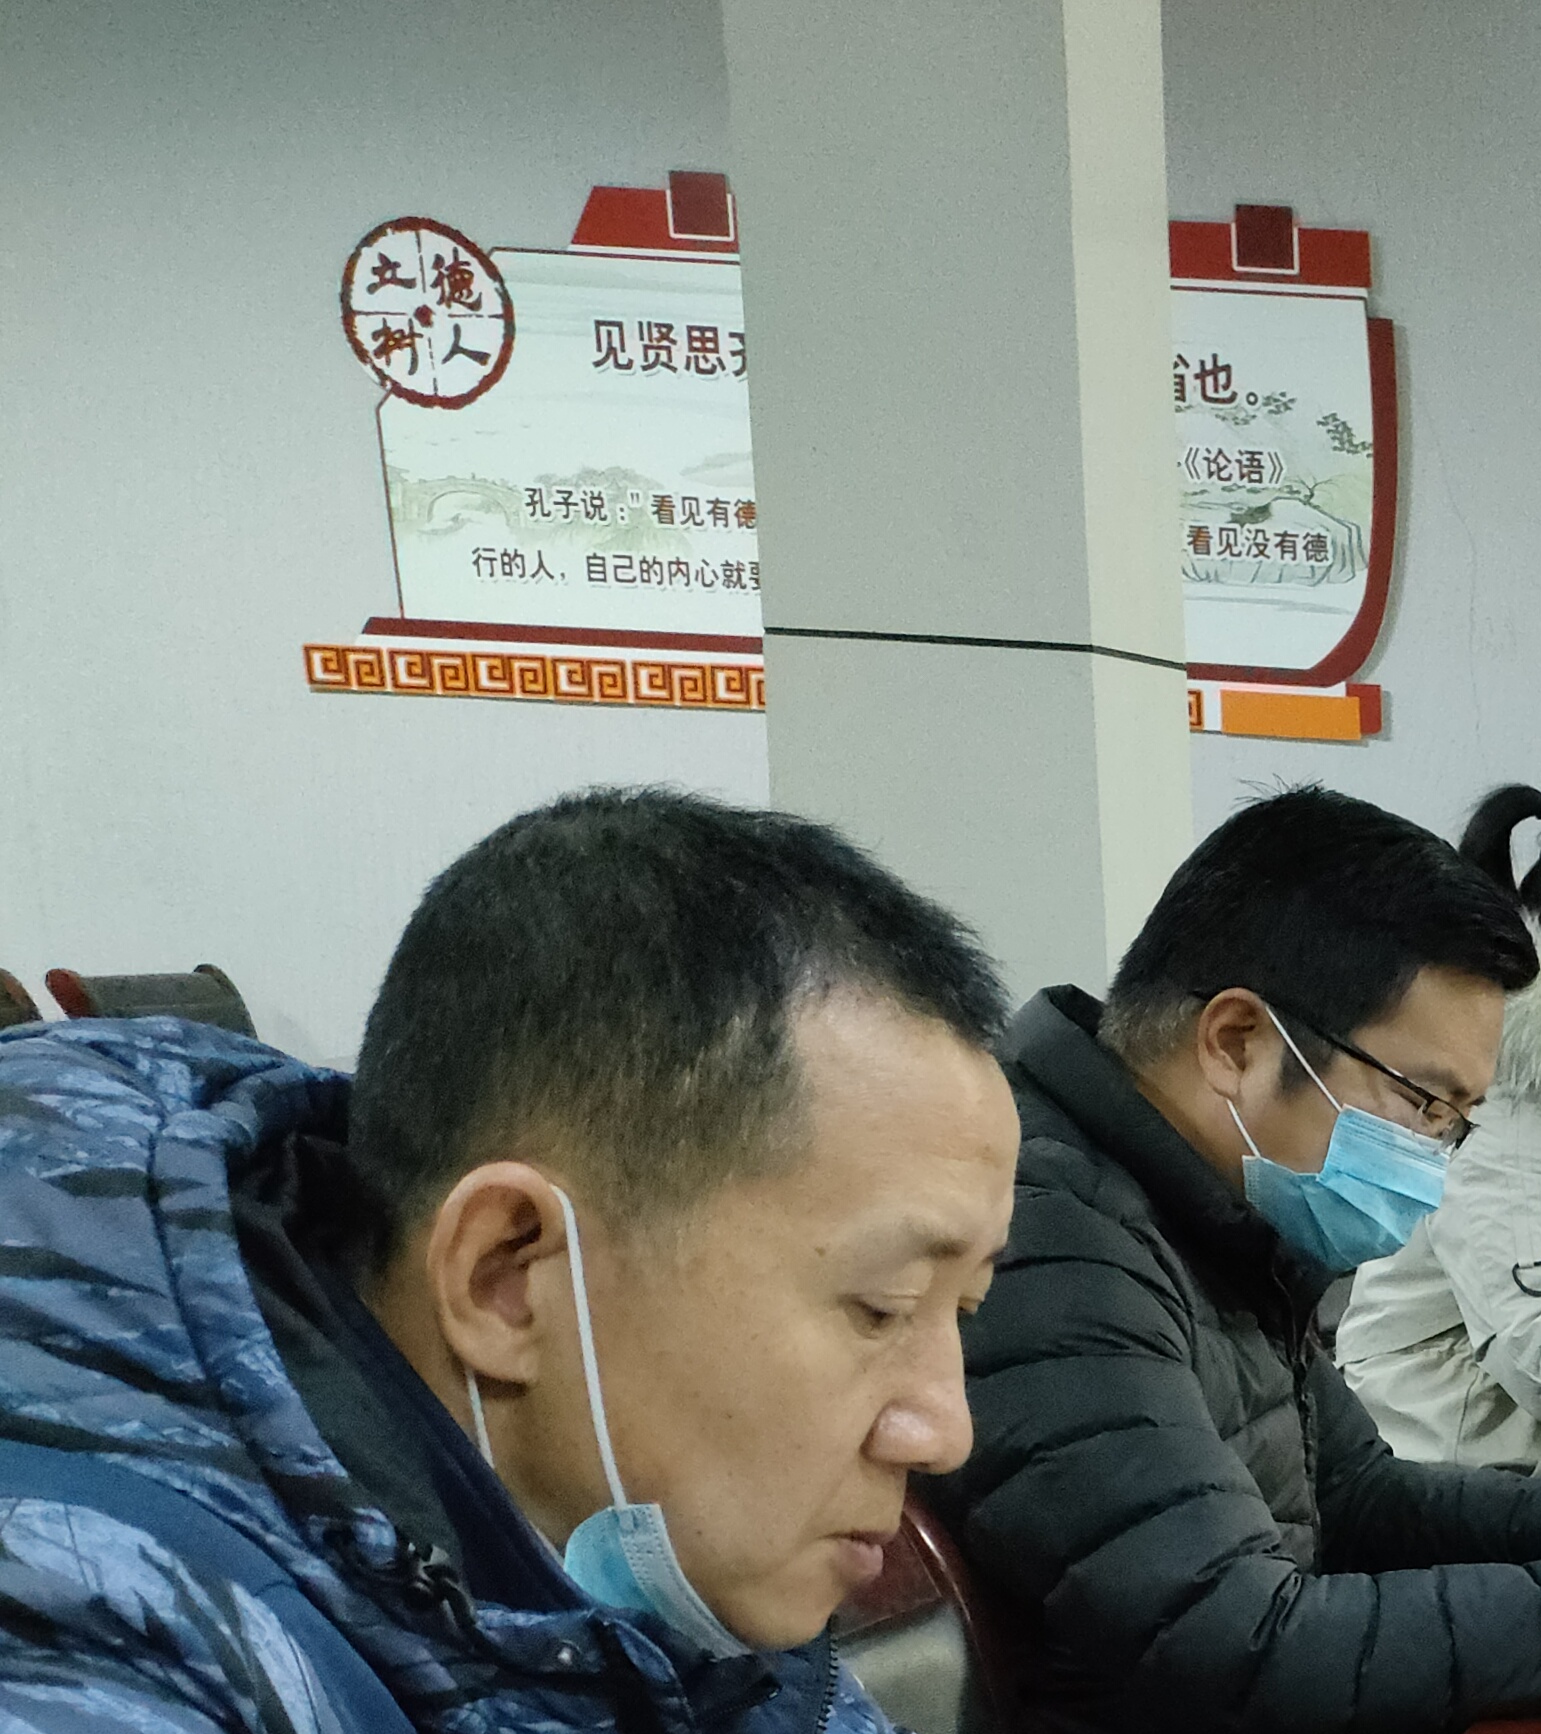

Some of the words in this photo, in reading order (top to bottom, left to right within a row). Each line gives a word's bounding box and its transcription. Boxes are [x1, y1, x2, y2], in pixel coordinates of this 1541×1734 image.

[1186, 524, 1330, 563] 看见没有德
